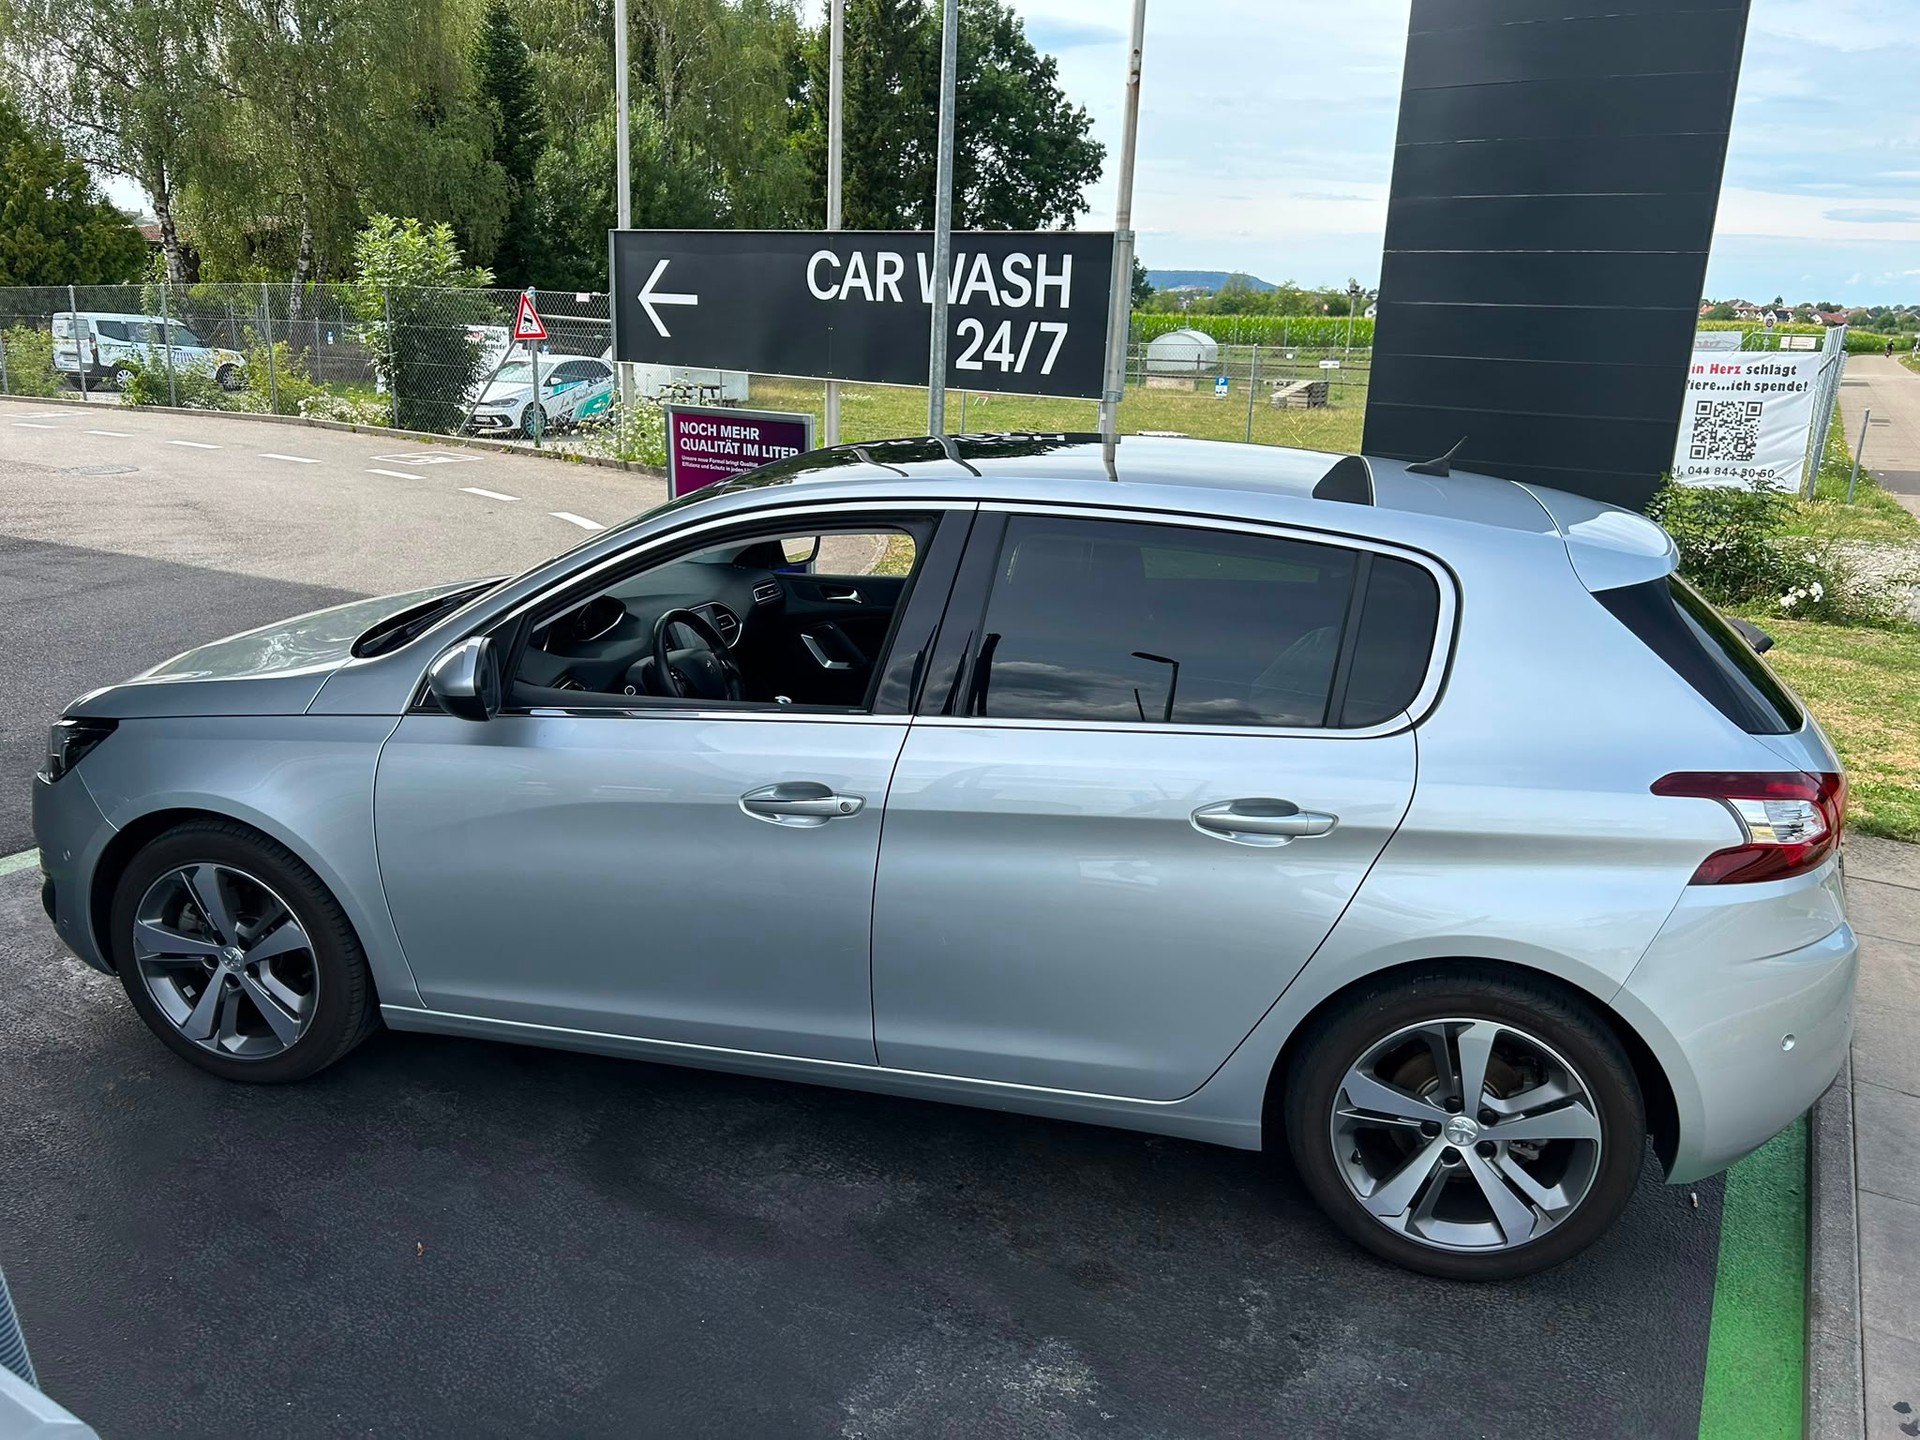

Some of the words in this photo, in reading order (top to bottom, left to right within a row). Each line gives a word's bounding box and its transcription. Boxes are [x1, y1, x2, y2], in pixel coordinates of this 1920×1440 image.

[806, 250, 904, 303] CAR
[916, 252, 1072, 308] WASH
[955, 317, 1068, 375] 24/7
[1709, 363, 1741, 374] Herz
[1746, 364, 1797, 377] schlägt
[1754, 380, 1808, 393] spende!
[680, 422, 716, 437] NOCH
[720, 425, 760, 440] MEHR
[680, 438, 740, 454] QUALITÄT
[743, 444, 759, 457] IM
[1688, 466, 1710, 475] 044
[1714, 466, 1737, 476] 844
